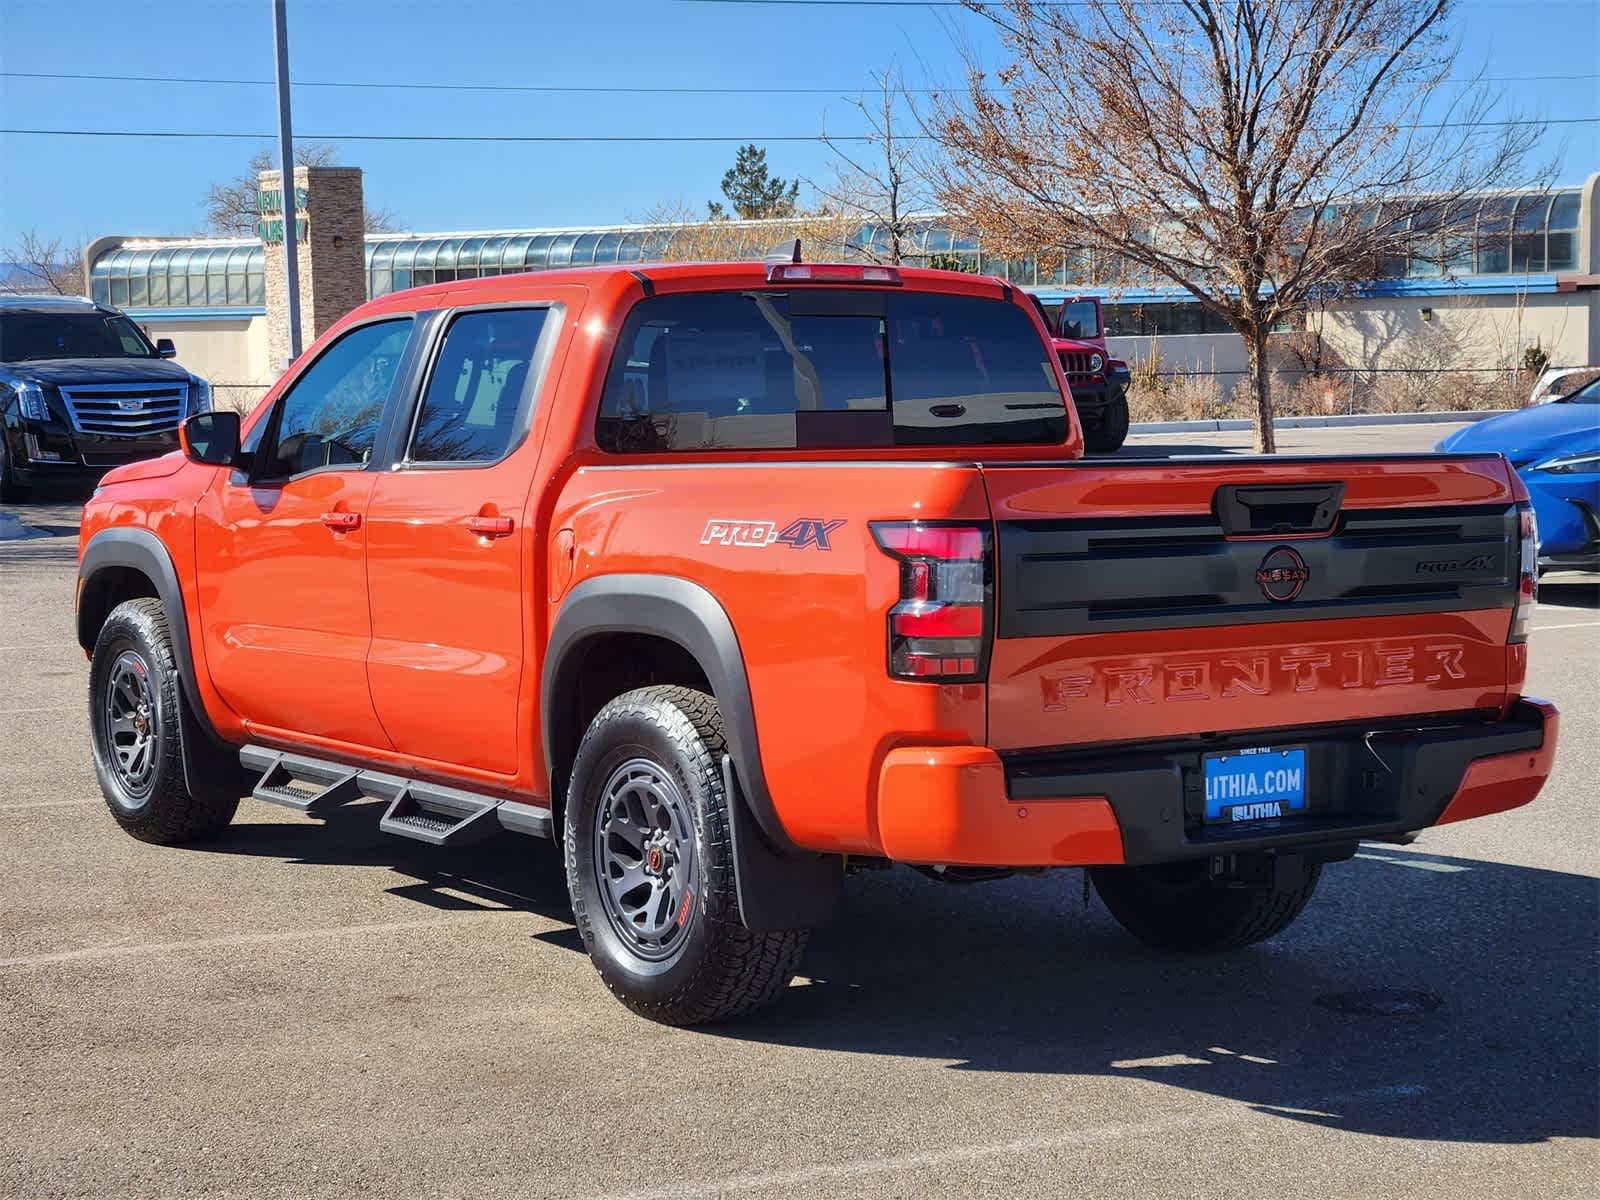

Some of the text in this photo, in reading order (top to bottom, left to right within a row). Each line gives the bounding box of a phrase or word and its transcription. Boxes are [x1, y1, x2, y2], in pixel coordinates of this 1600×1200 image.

[1256, 568, 1309, 584] NISSAN
[1040, 644, 1467, 712] FRONTIER
[1205, 768, 1301, 801] LITHIA.COM
[1244, 802, 1281, 820] LITHIA
